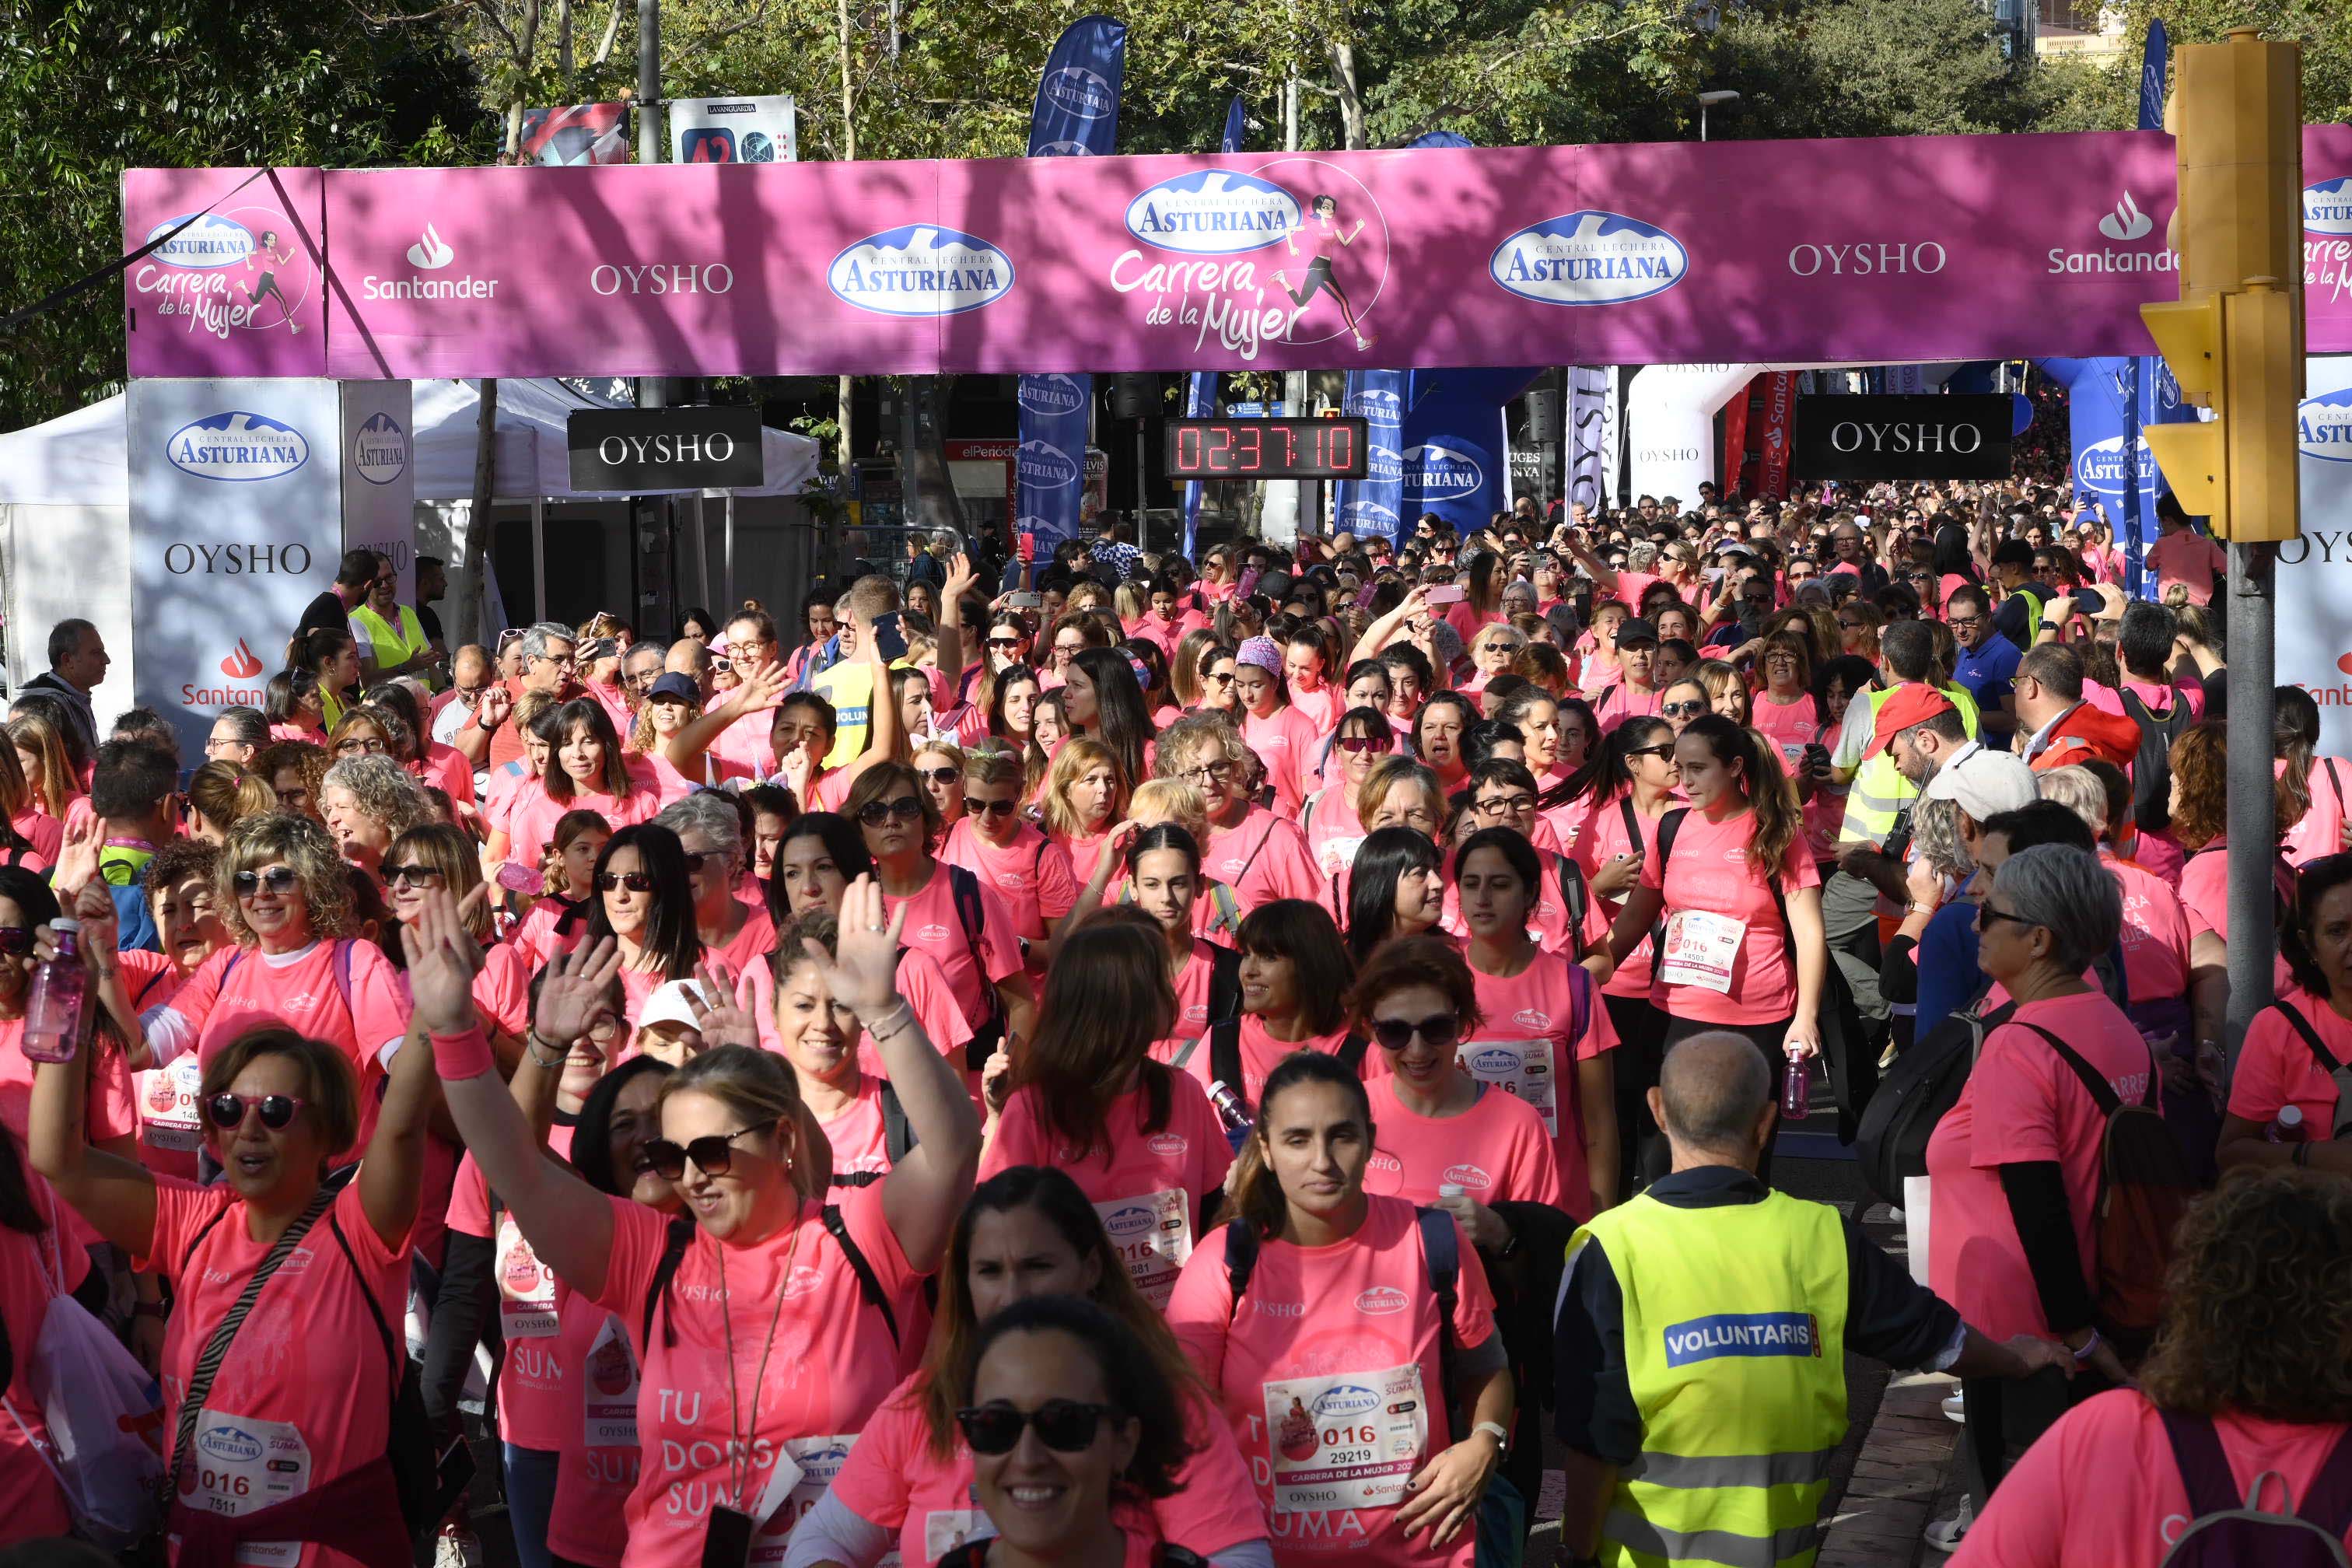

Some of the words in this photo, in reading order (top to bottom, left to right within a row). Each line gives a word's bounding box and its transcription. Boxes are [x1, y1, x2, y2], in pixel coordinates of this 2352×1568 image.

[1166, 198, 1222, 208] CENTRAL
[1227, 198, 1283, 207] LECHERA
[1139, 200, 1287, 233] ASTURIANA
[155, 239, 247, 255] ASTURIANA
[1535, 243, 1598, 254] CENTRAL
[1604, 242, 1665, 252] LECHERA
[870, 255, 929, 264] CENTRAL
[1506, 248, 1672, 282] ASTURIANA
[1789, 243, 1946, 276] OYSHO
[135, 264, 226, 294] Carrera
[590, 264, 733, 295] OYSHO
[843, 260, 1001, 292] ASTURIANA
[1109, 249, 1256, 295] Carrera
[2321, 263, 2334, 285] la
[363, 275, 499, 300] Santander
[158, 297, 176, 315] de
[178, 296, 191, 315] la
[189, 294, 261, 340] Mujer
[1146, 296, 1172, 326] de
[1178, 294, 1198, 326] la
[1195, 287, 1310, 361] Mujer
[1179, 427, 1352, 470] 02:37:10
[1831, 422, 1981, 453] OYSHO
[178, 438, 299, 464] ASTURIANA
[359, 446, 404, 467] ASTURIANA
[599, 432, 734, 466] OYSHO
[1640, 448, 1699, 463] OYSHO
[164, 543, 311, 575] OYSHO
[1683, 940, 1707, 952] 016
[1684, 953, 1704, 961] 14503
[1475, 1059, 1517, 1069] ASTURIANA
[153, 1120, 181, 1129] CARRERA
[149, 1132, 181, 1143] OYSHO
[1108, 1217, 1152, 1232] ASTURIANA
[1358, 1294, 1407, 1309] ASTURIANA
[515, 1320, 556, 1329] OYSHO
[1668, 1324, 1809, 1355] VOLUNTARIS
[659, 1388, 701, 1425] TU
[1318, 1398, 1376, 1412] ASTURIANA
[1386, 1384, 1414, 1395] SUMA
[204, 1436, 256, 1456] ASTURIANA
[268, 1440, 300, 1451] SUMA
[1324, 1426, 1376, 1446] 016
[1330, 1450, 1371, 1464] 29219
[201, 1470, 250, 1496] 016
[1291, 1472, 1334, 1482] CARRERA
[1336, 1470, 1349, 1479] DE
[1350, 1468, 1362, 1477] LA
[1363, 1465, 1395, 1476] MUJER
[208, 1497, 236, 1514] 7511
[1290, 1490, 1337, 1503] OYSHO
[1269, 1506, 1367, 1538] UMA
